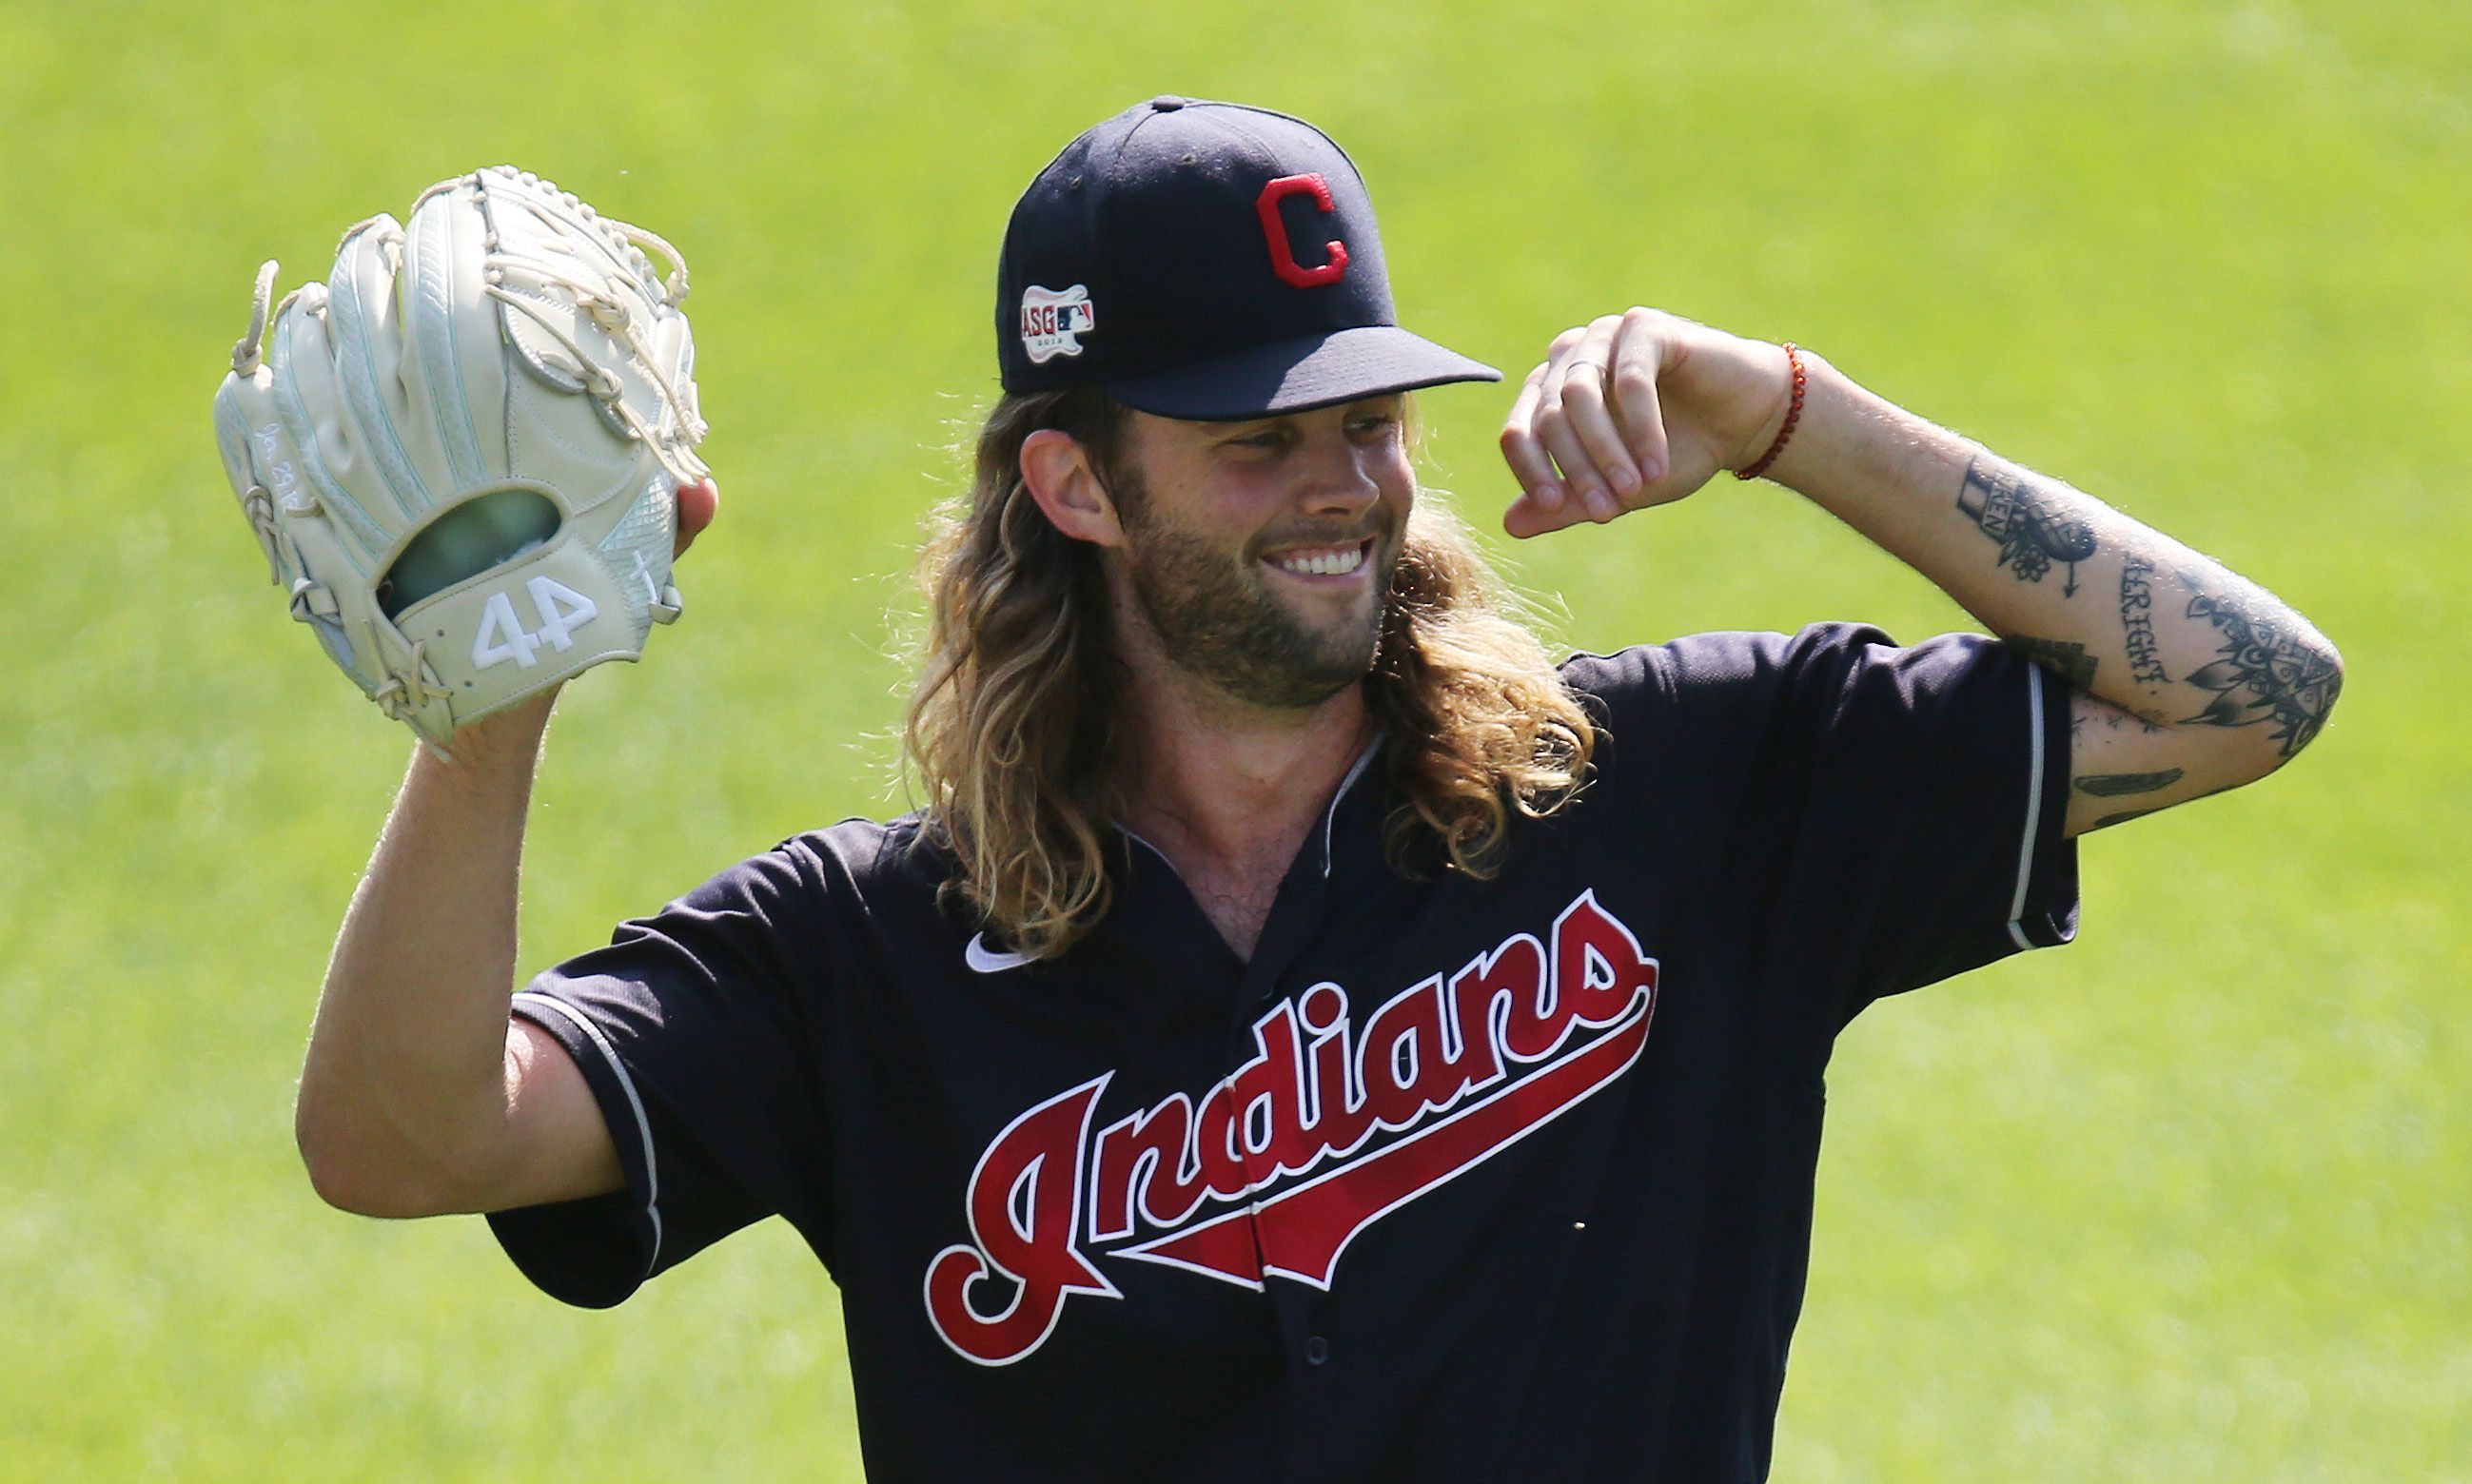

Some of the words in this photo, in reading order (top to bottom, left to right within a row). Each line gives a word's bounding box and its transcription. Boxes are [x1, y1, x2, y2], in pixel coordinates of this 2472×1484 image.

[1255, 171, 1350, 289] C
[1023, 305, 1056, 337] ASG
[471, 574, 598, 671] 44
[923, 887, 1659, 1367] Indians
